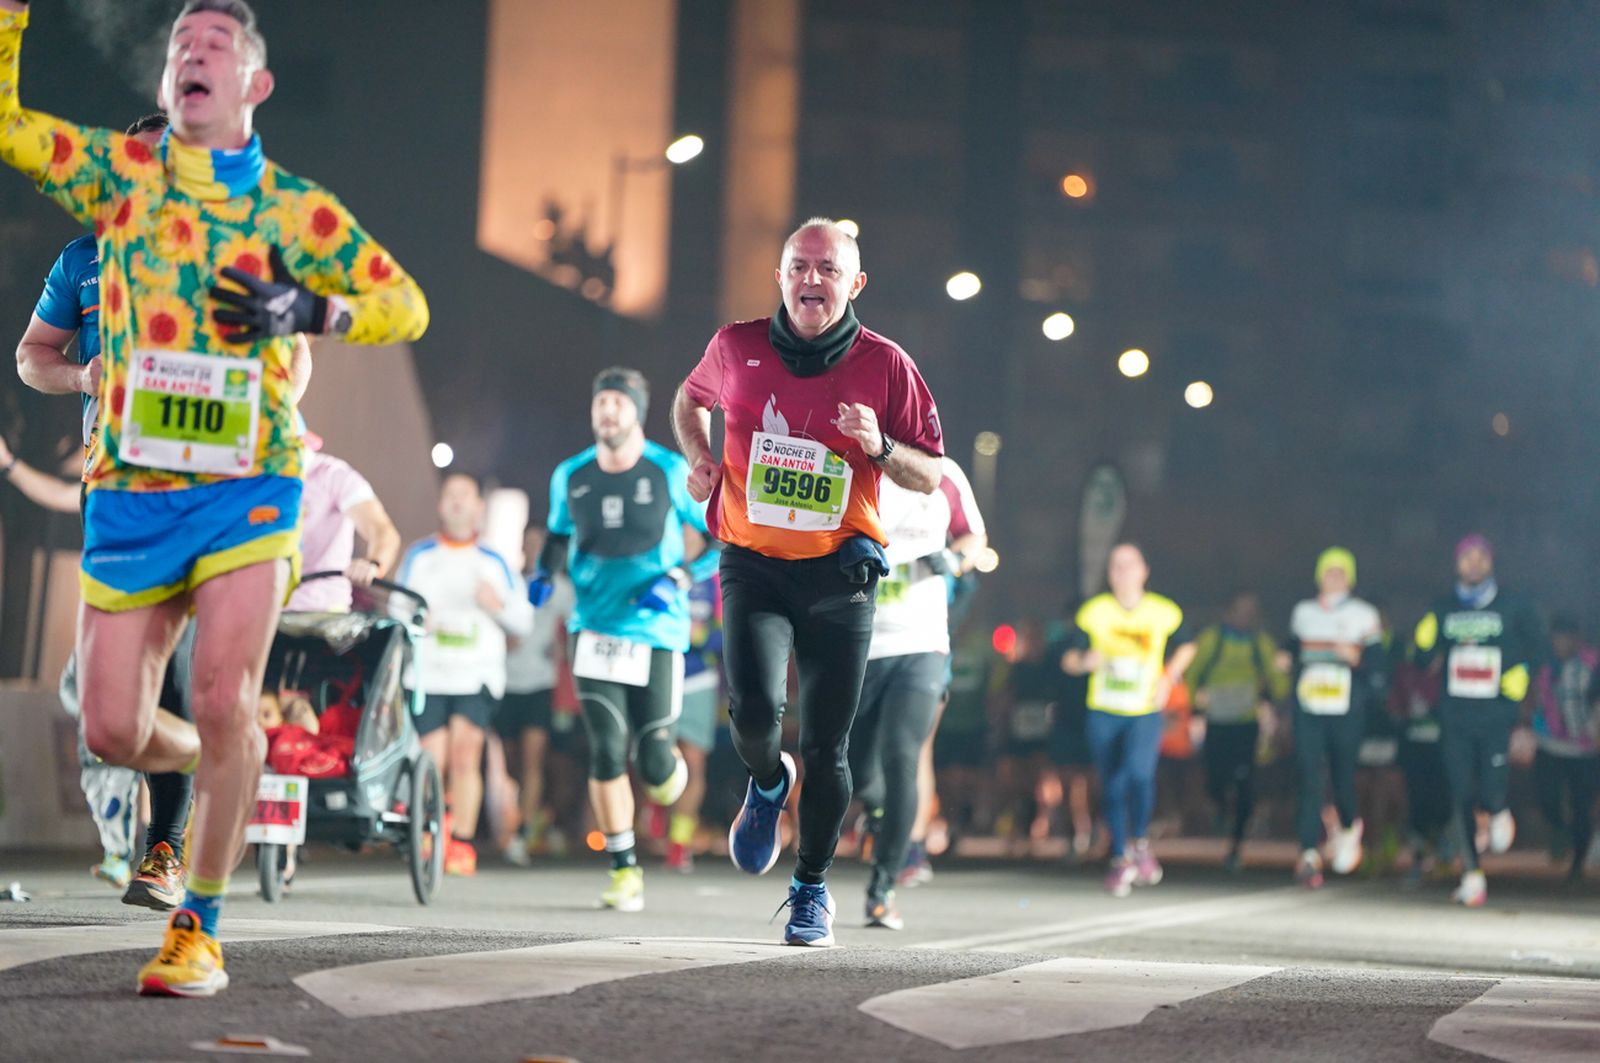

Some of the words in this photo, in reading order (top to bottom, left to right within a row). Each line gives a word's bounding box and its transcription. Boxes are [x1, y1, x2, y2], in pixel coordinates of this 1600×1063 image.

[158, 394, 225, 434] 1110
[760, 454, 780, 466] SAN
[773, 445, 804, 459] NOCHE
[804, 450, 817, 461] DE
[763, 467, 832, 503] 9596
